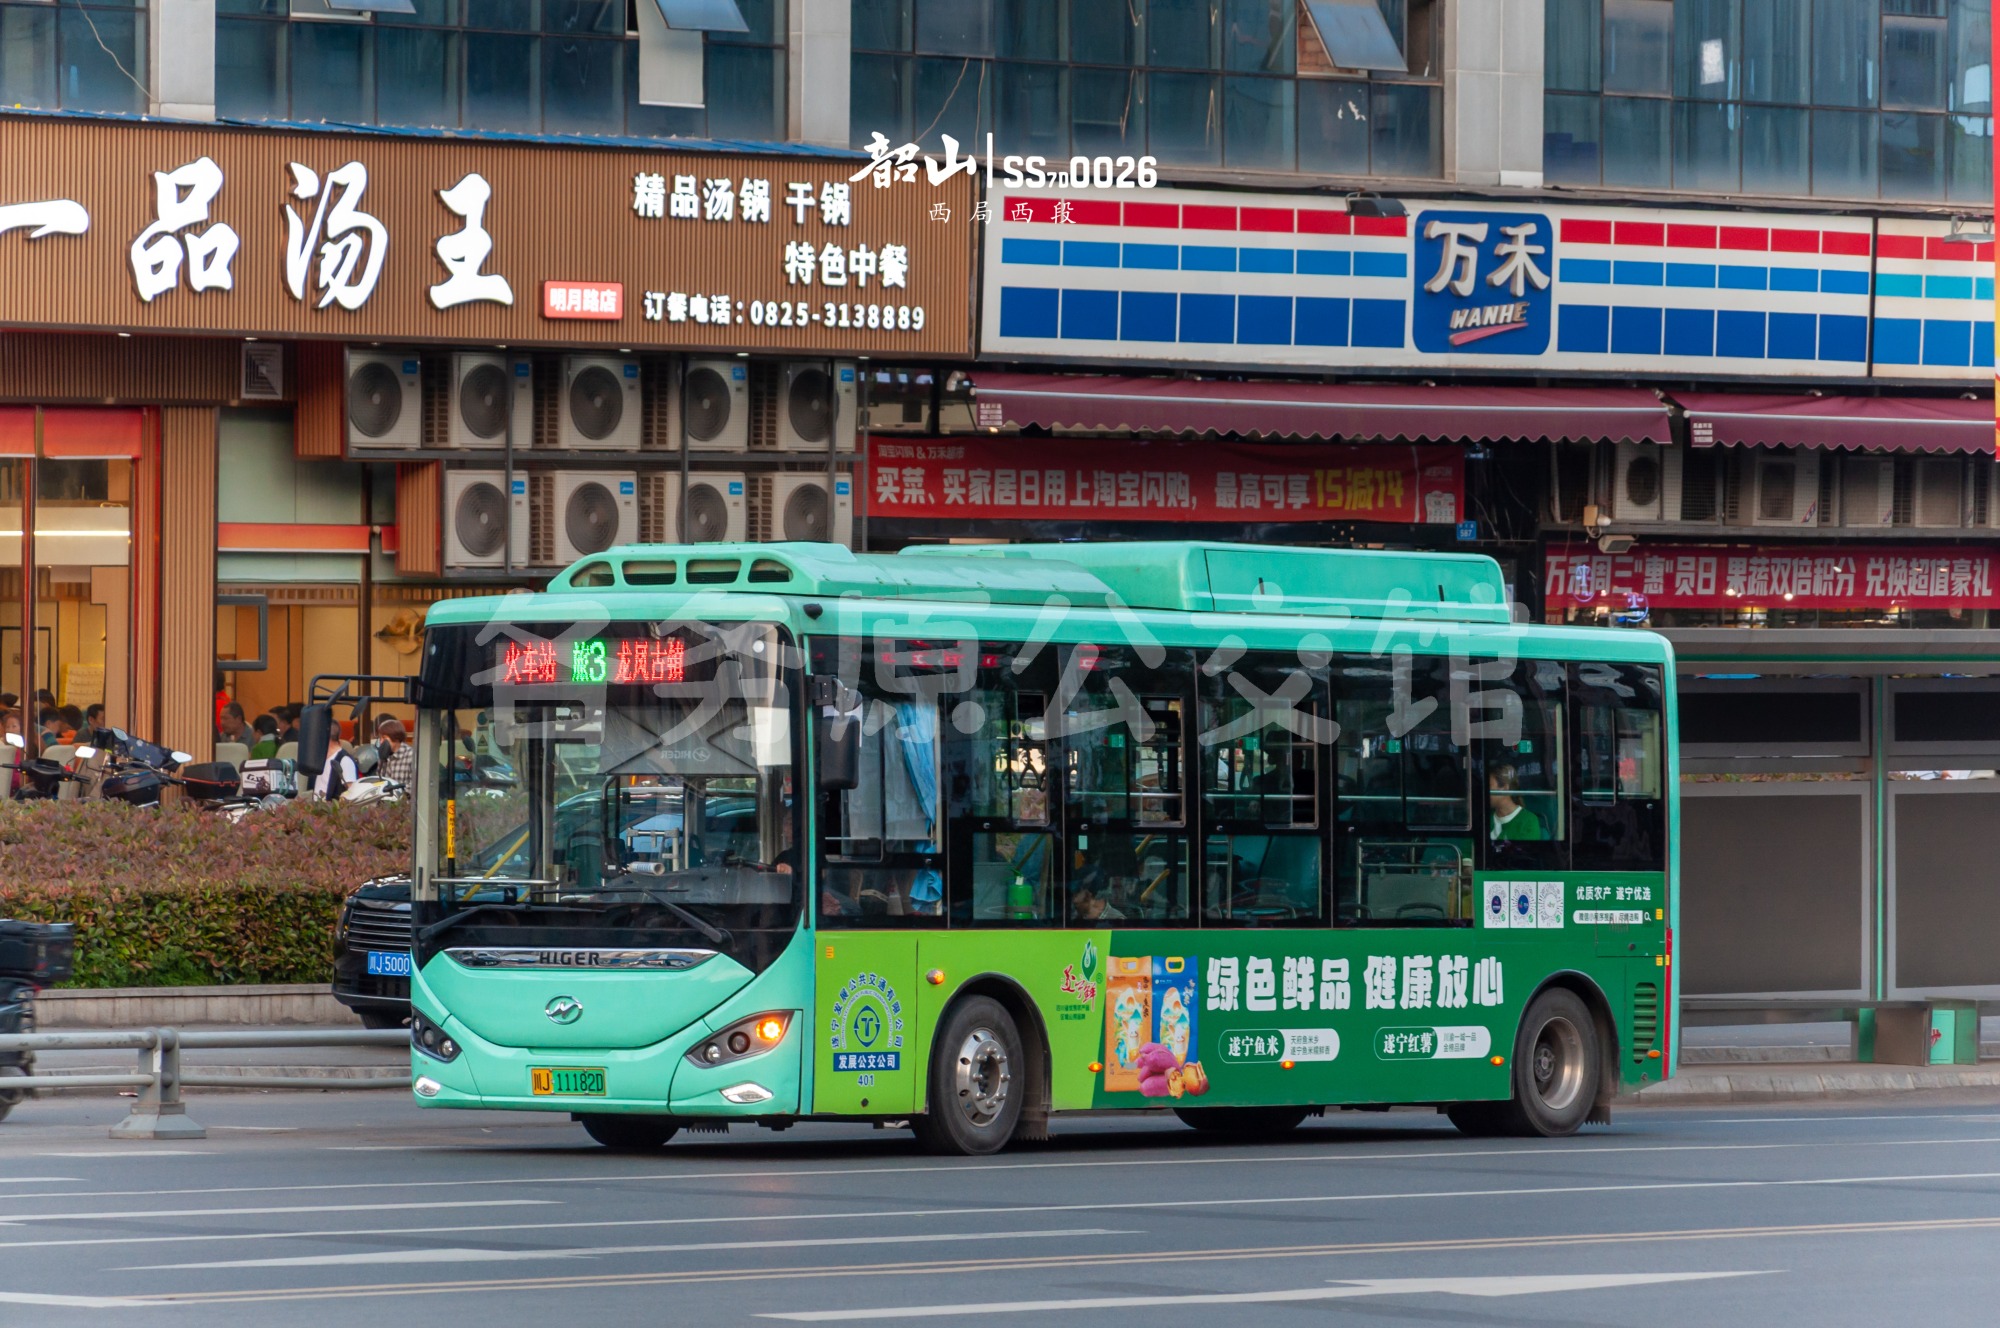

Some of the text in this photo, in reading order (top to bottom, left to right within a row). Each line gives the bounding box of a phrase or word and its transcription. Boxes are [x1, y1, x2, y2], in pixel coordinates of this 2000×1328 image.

[633, 173, 851, 226] 精品汤锅 干锅
[0, 156, 514, 311] 一品汤王
[784, 241, 908, 288] 特色中餐
[1424, 220, 1550, 297] 万禾
[550, 287, 617, 313] 明月路店
[1450, 302, 1530, 329] WANHE
[1726, 556, 1857, 597] 果蔬双倍积分
[1865, 557, 1993, 597] 兑换超值豪礼
[504, 641, 556, 683] 火车站
[615, 640, 684, 682] 龙凤古镇
[1576, 886, 1651, 901] 优质农产 遂宁优选
[369, 955, 410, 972] 川J·5000
[540, 951, 600, 965] HIGER
[1206, 956, 1350, 1012] 绿色鲜品
[1363, 954, 1505, 1009] 健康放心
[1228, 1035, 1279, 1056] 遂宁鱼米
[1383, 1032, 1433, 1053] 遂宁红薯
[838, 1054, 896, 1069] 发展公交公司
[857, 1074, 875, 1086] 401
